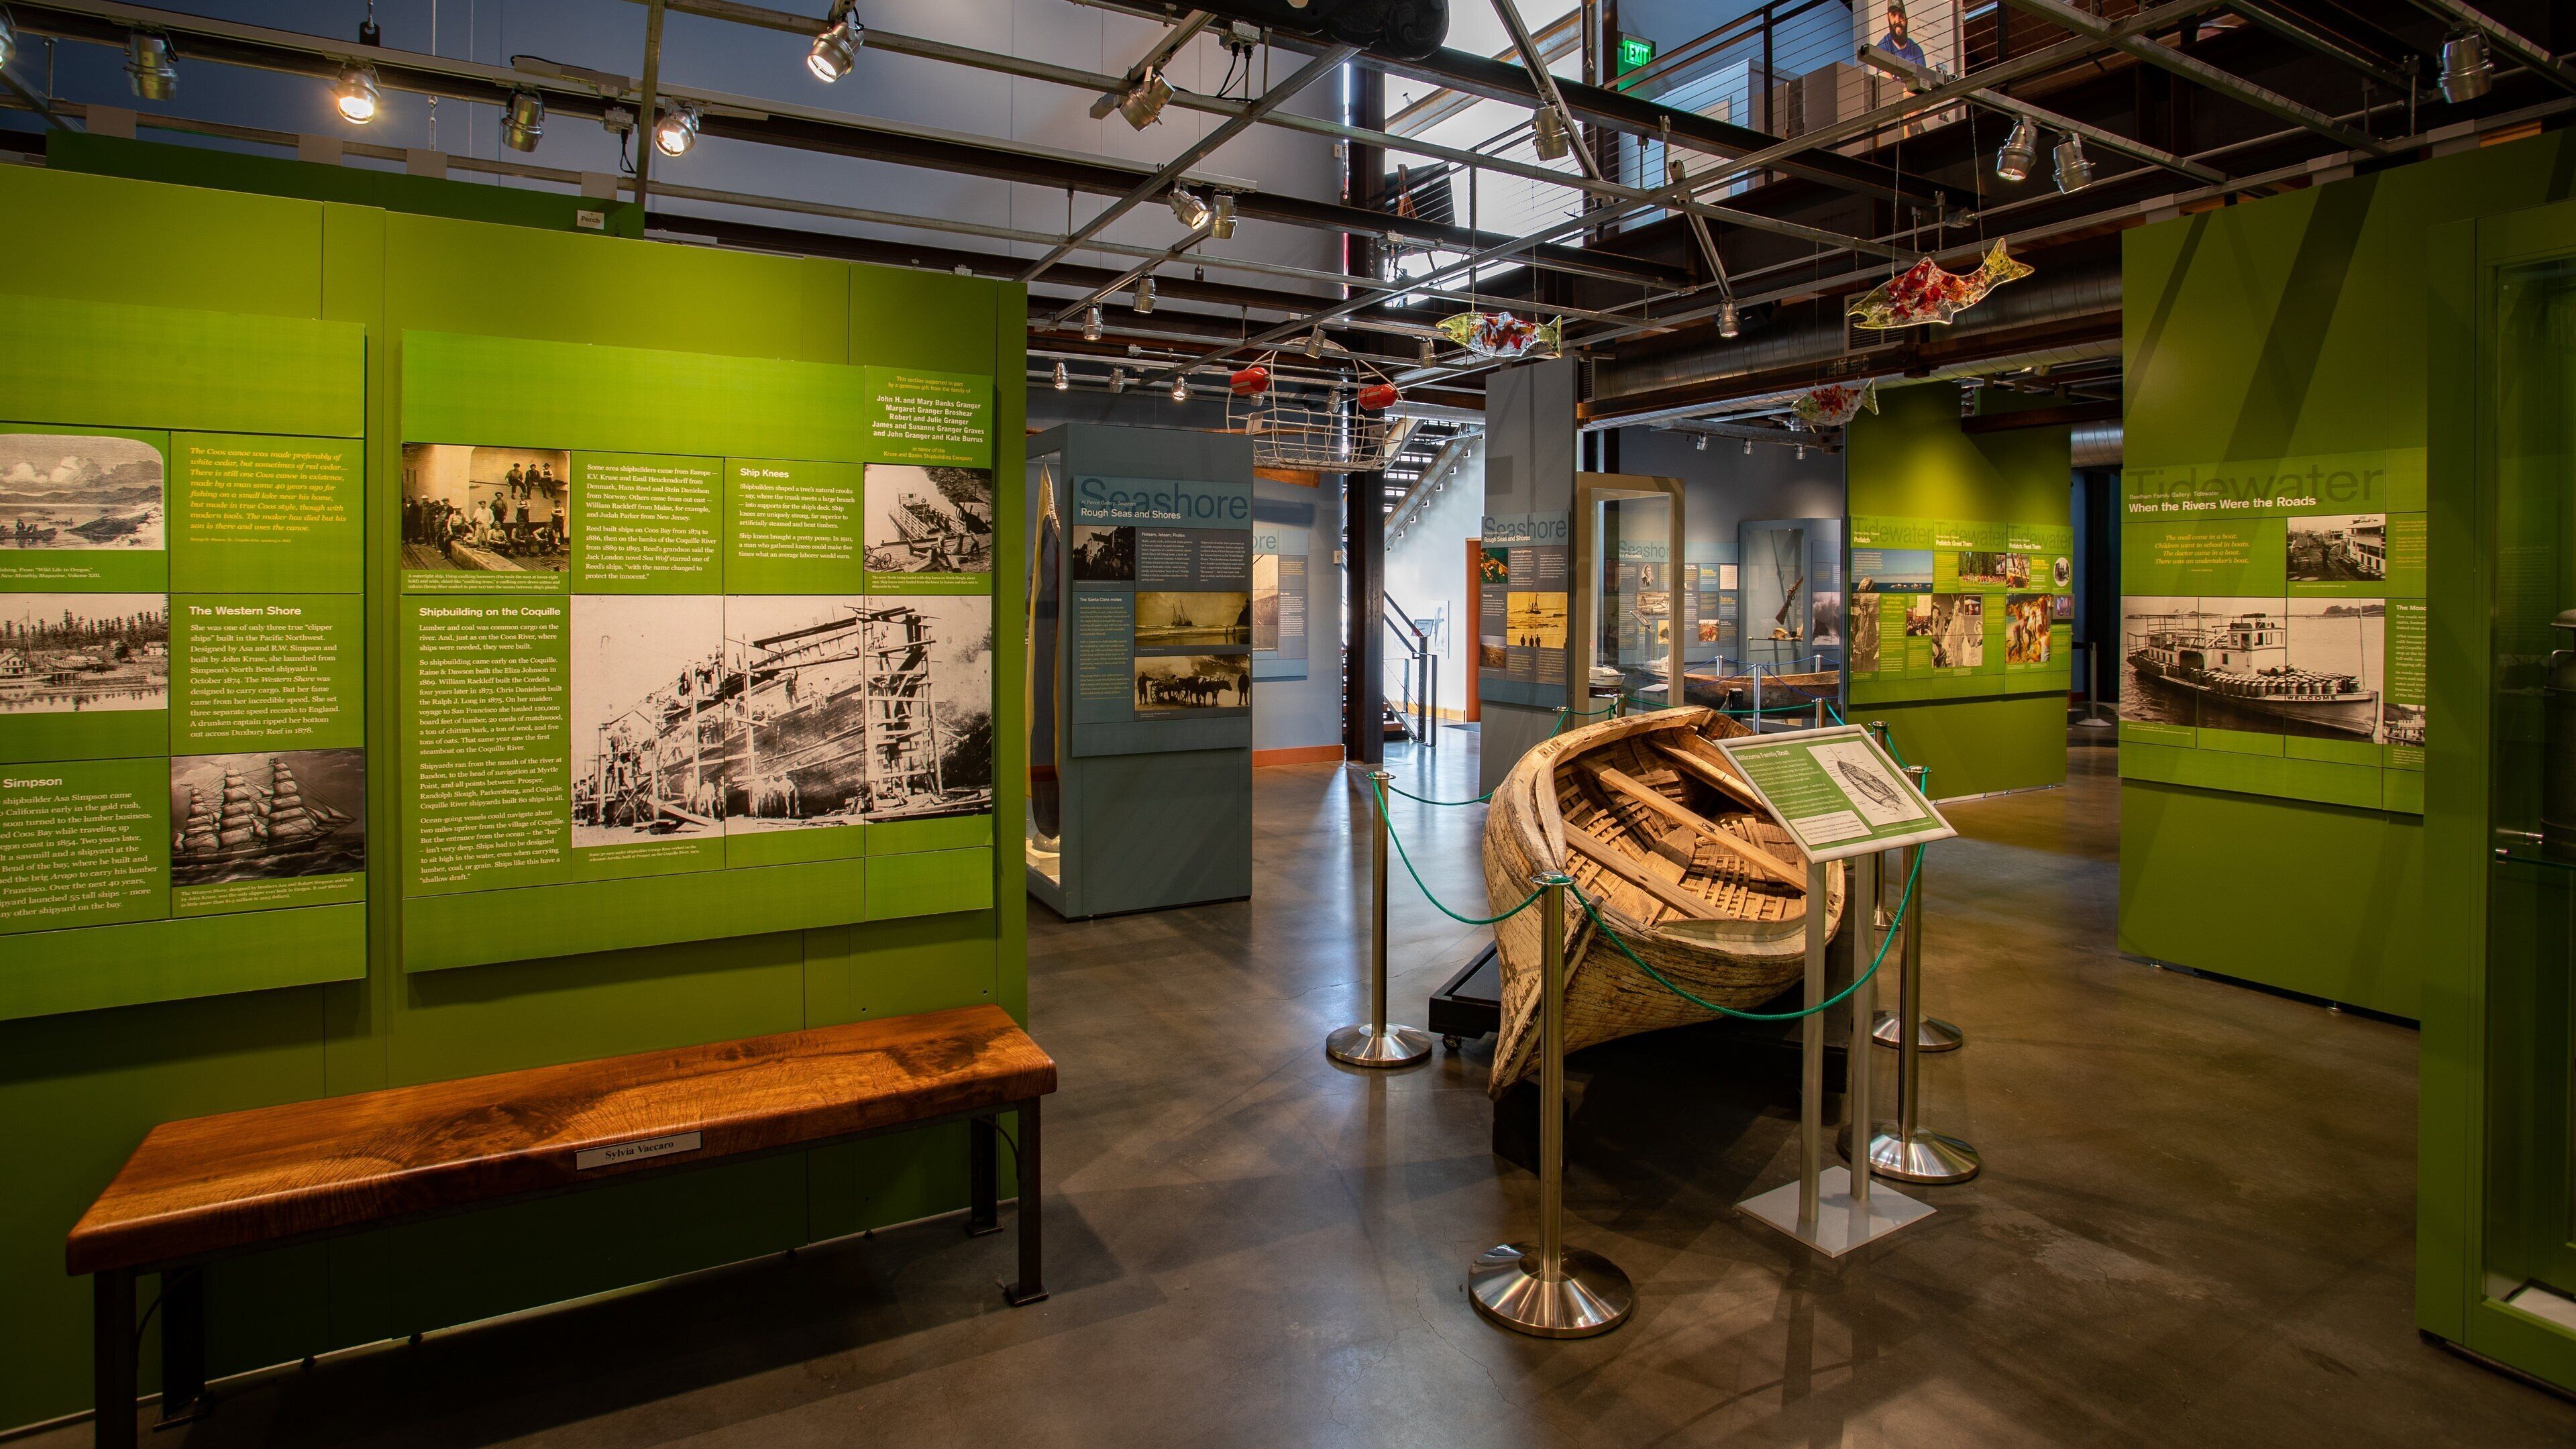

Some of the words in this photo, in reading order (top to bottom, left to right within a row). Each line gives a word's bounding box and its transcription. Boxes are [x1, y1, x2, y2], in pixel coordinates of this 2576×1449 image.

[1629, 43, 1649, 65] EXIT
[580, 215, 600, 223] Perch
[876, 394, 893, 402] John
[916, 398, 933, 407] Mary
[935, 399, 954, 407] Banks
[956, 400, 981, 410] Granger
[885, 404, 915, 414] Margaret
[917, 406, 943, 416] Granger
[945, 408, 973, 417] Broshear
[889, 413, 912, 421] Robert
[943, 416, 969, 425] Granger
[872, 421, 893, 429] James
[908, 423, 935, 431] Susanne
[936, 424, 962, 434] Granger
[886, 430, 903, 438] John
[945, 433, 960, 441] Kate
[962, 435, 983, 443] Burrus
[292, 452, 331, 462] preferably
[620, 465, 656, 474] shipbuilders
[740, 468, 760, 478] Ship
[762, 469, 790, 478] Knees
[2126, 464, 2384, 504] Tidewater
[1079, 478, 1248, 520] Seashore
[2129, 503, 2158, 513] When
[2161, 502, 2179, 511] the
[2182, 500, 2216, 511] Rivers
[2220, 499, 2249, 509] Were
[2253, 498, 2273, 508] the
[2276, 496, 2316, 507] Roads
[1081, 508, 1108, 519] Rough
[1111, 509, 1132, 518] Seas
[1134, 510, 1149, 518] and
[1152, 510, 1181, 519] Shores
[1484, 515, 1566, 539] Seashore
[1852, 517, 1933, 544] Tidewater
[1935, 521, 2006, 547] Tidewater
[2008, 525, 2073, 549] Tidewater
[189, 606, 212, 615] The
[215, 606, 263, 615] Western
[266, 606, 302, 615] Shore
[419, 607, 482, 618] Shipbuilding
[501, 607, 518, 616] the
[520, 607, 561, 617] Coquille
[248, 624, 265, 632] only
[1735, 753, 1760, 761] Millicoma
[3, 778, 62, 788] Simpson
[605, 1148, 634, 1160] Sylvia
[637, 1141, 674, 1153] Vaccaro
